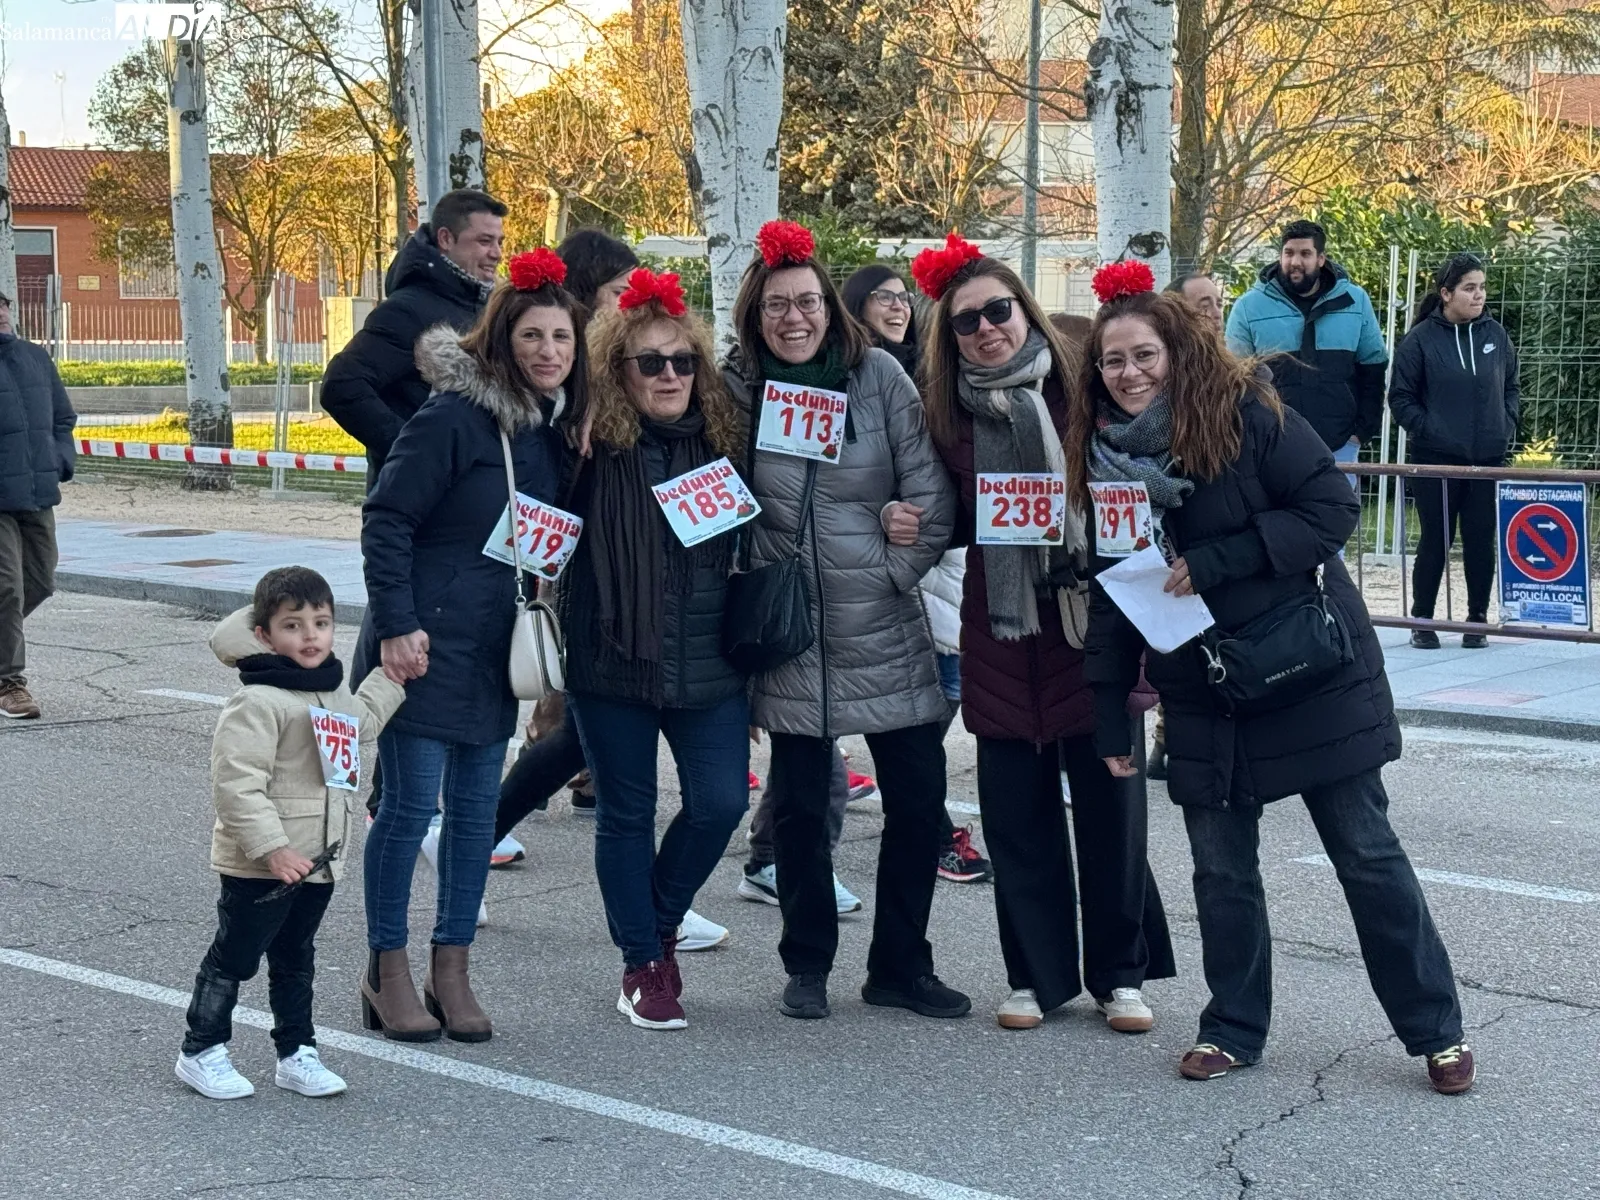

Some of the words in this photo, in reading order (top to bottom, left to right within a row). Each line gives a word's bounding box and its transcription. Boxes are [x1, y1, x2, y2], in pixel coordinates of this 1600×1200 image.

[766, 385, 845, 414] bedunia
[780, 407, 833, 443] 113
[655, 465, 734, 505] bedunia
[979, 477, 1064, 495] bedunia
[1500, 488, 1538, 501] PROHIBIDO
[1538, 488, 1583, 502] ESTACIONAR
[677, 482, 736, 526] 185
[991, 496, 1052, 528] 238
[1100, 505, 1136, 539] 291
[1512, 590, 1551, 602] POLICÍA
[1552, 593, 1584, 604] LOCAL
[313, 713, 357, 739] edunia
